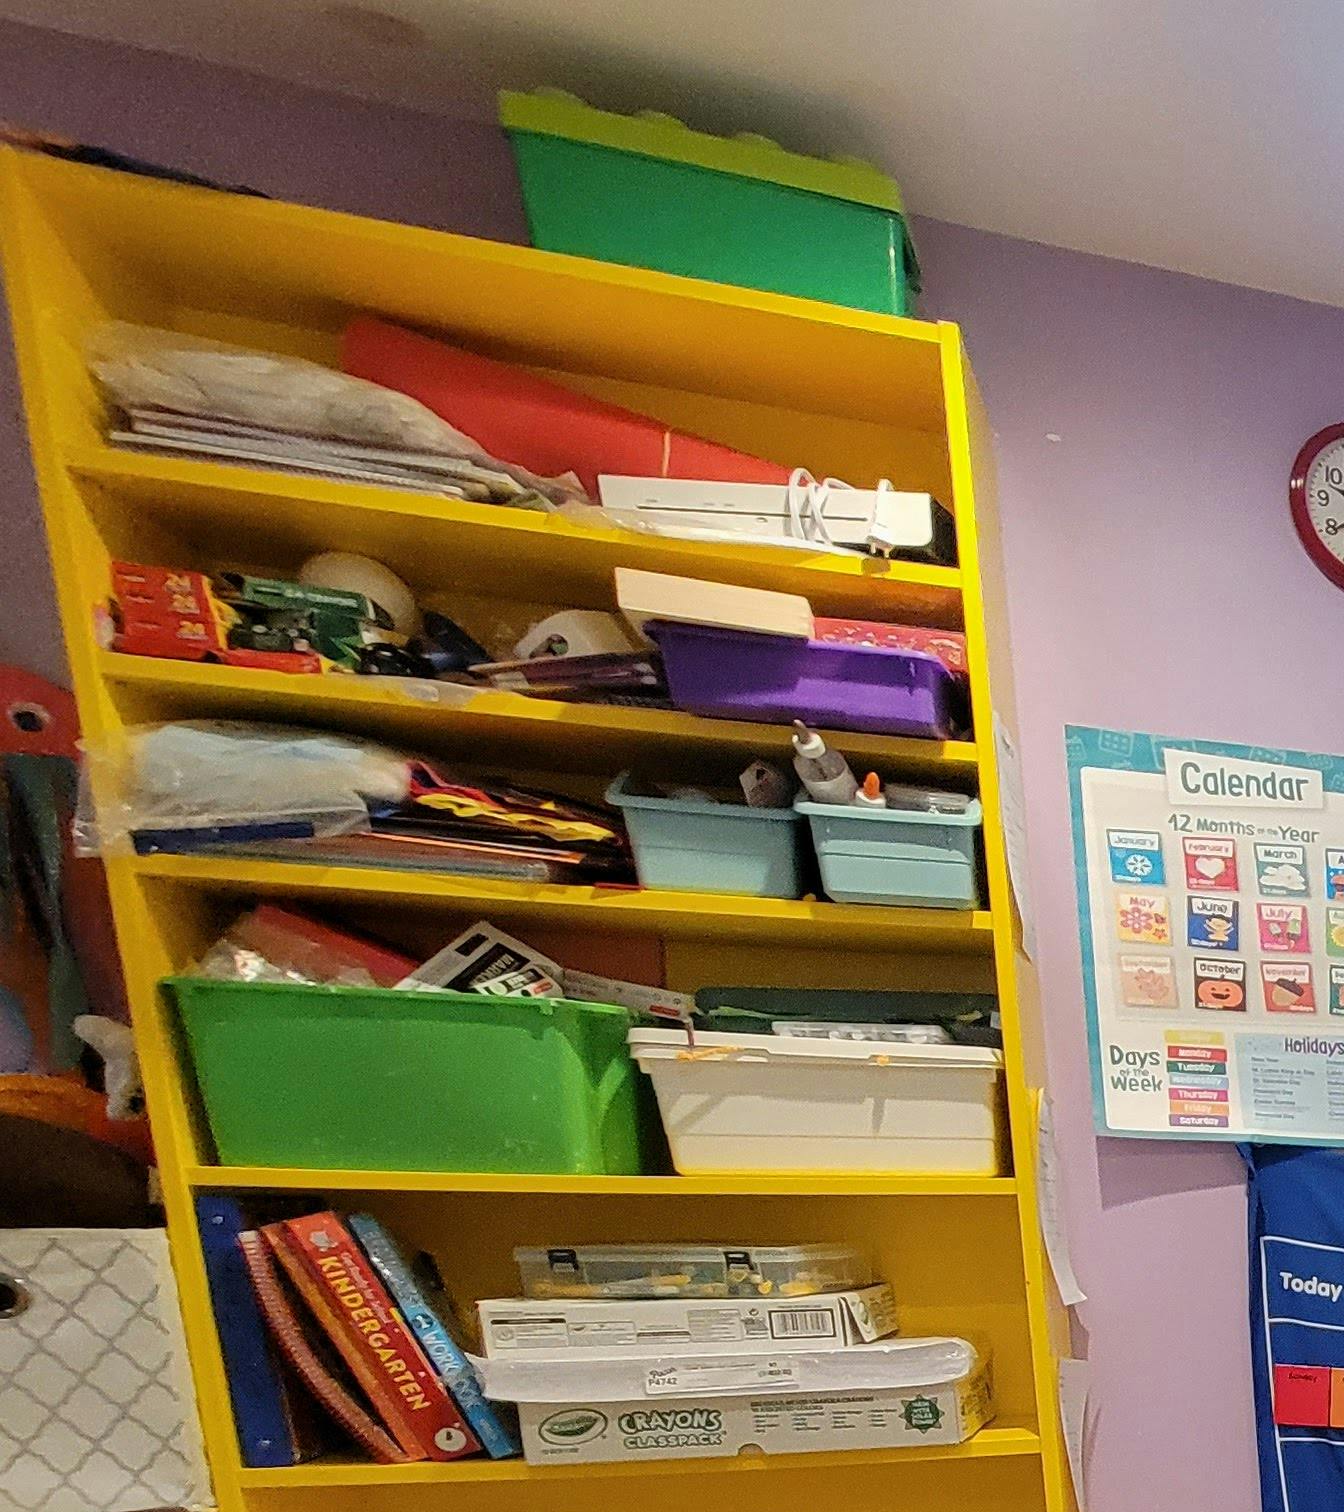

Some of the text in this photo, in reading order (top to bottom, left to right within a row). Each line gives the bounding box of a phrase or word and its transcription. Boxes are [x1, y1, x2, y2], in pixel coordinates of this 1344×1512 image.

[1325, 466, 1342, 484] 10
[1317, 489, 1329, 506] 9
[1325, 519, 1338, 535] 8
[1180, 761, 1309, 801] Calendar
[1168, 814, 1320, 843] 12 Months Year
[1264, 849, 1297, 859] March
[1129, 897, 1154, 908] May
[1197, 903, 1227, 914] June
[1266, 909, 1292, 919] July
[1200, 963, 1241, 974] October
[1179, 1049, 1211, 1058] Monday
[1285, 1037, 1344, 1057] Holidays
[1109, 1045, 1160, 1068] Days
[1177, 1063, 1215, 1073] Tuesday
[1111, 1074, 1162, 1091] Week
[1178, 1090, 1218, 1099] Thursday
[1180, 1116, 1218, 1125] Saturday
[1280, 1272, 1342, 1301] Today
[319, 1256, 432, 1411] KINDERGARTEN
[648, 1378, 677, 1386] P4742
[617, 1408, 723, 1434] CRAYONS
[623, 1431, 722, 1450] CLASSPACK
